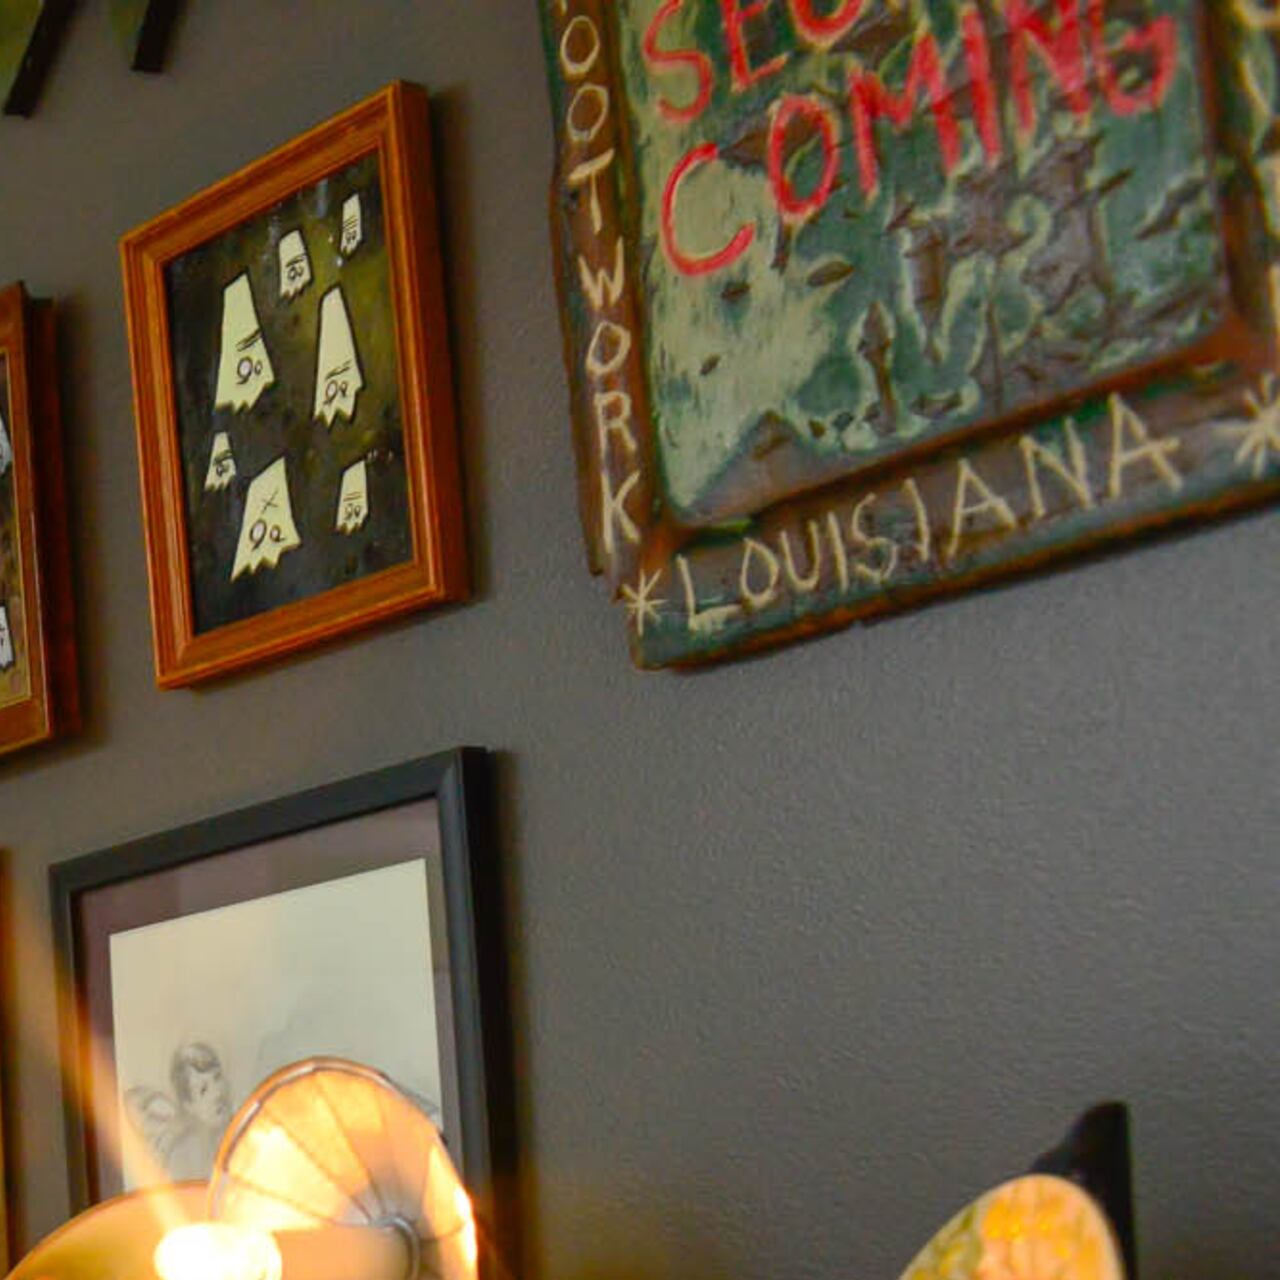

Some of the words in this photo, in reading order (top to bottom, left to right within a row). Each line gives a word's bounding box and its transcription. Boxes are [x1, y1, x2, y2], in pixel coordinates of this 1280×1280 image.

[558, 0, 616, 234] OOT
[661, 0, 1177, 276] COMING
[577, 236, 640, 554] WORK
[677, 392, 1183, 632] LOUISIANA
